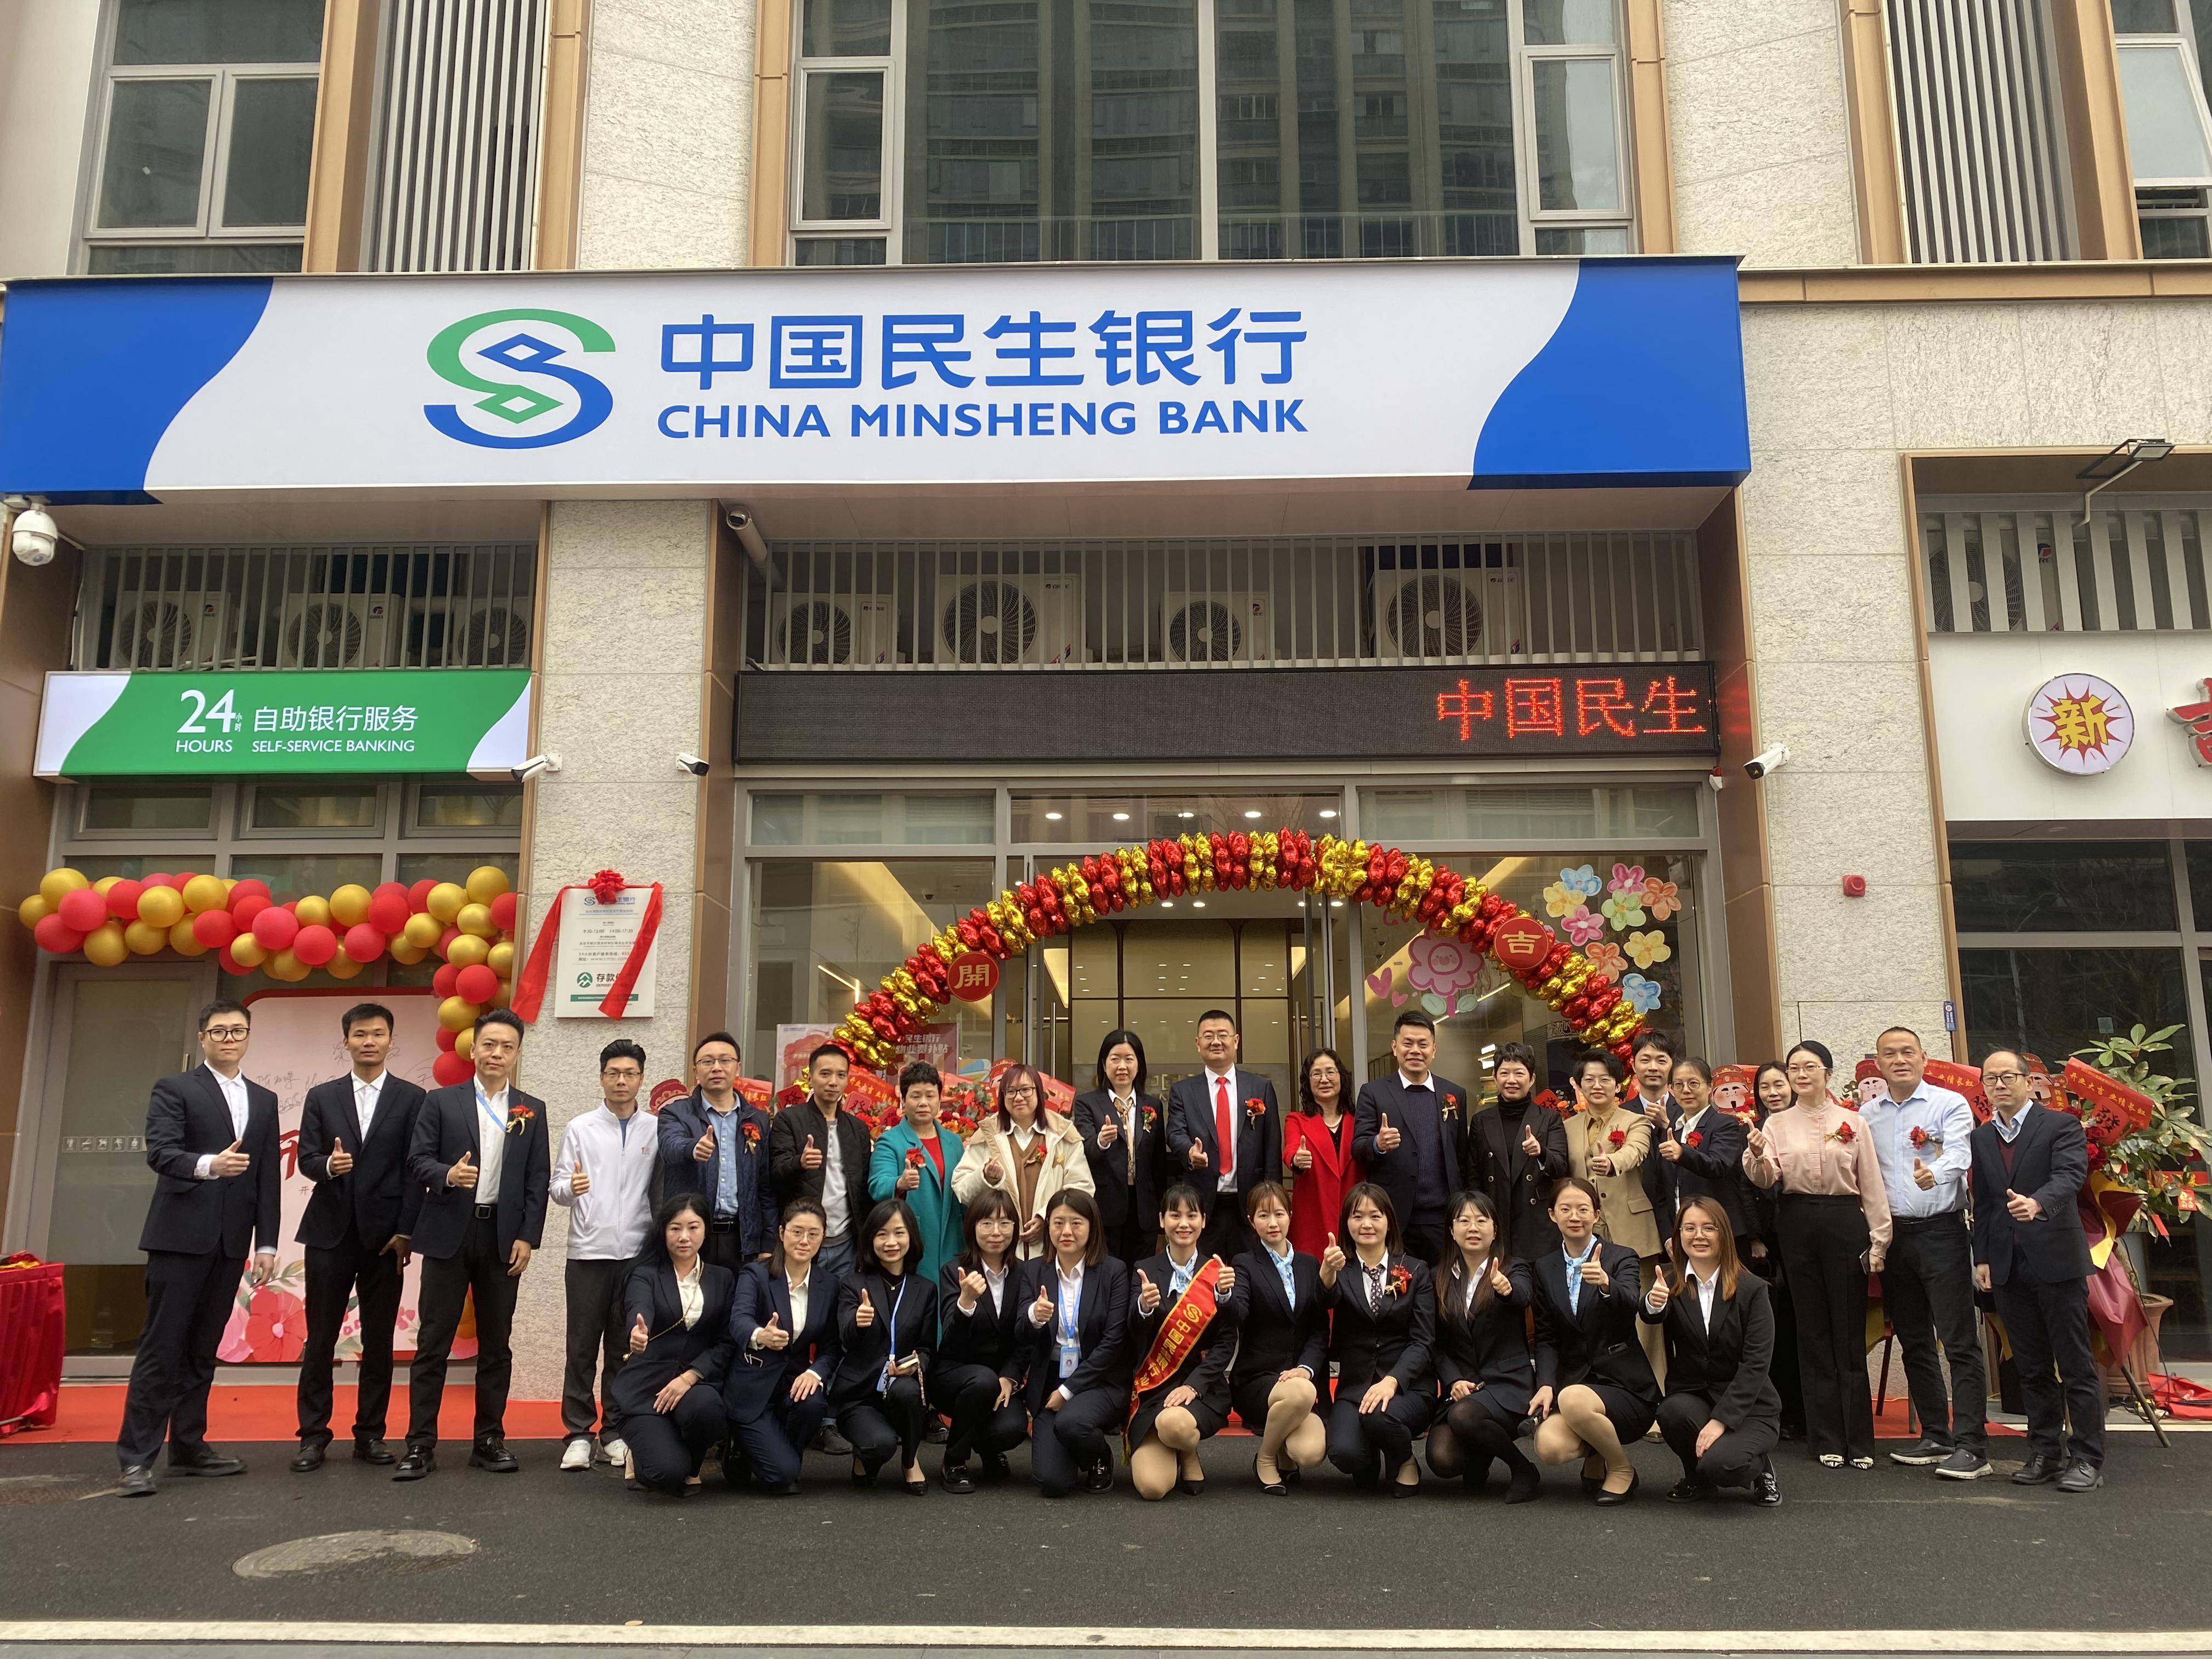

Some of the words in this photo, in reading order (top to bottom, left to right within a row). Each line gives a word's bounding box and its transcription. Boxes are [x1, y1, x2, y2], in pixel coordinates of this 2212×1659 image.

[661, 308, 1307, 391] 中国民生银行
[658, 404, 831, 439] CHINA
[851, 402, 1137, 438] MINSHENG
[1159, 399, 1308, 435] BANK
[176, 689, 236, 733] 24
[255, 706, 419, 733] 自助银行服务
[1437, 676, 1707, 741] 中国民生
[2052, 694, 2109, 750] 新
[176, 740, 233, 753] HOURS
[252, 740, 343, 753] SELF-SERVICE
[346, 740, 415, 753] BANKING
[1502, 930, 1542, 955] 吉
[953, 964, 990, 989] 開
